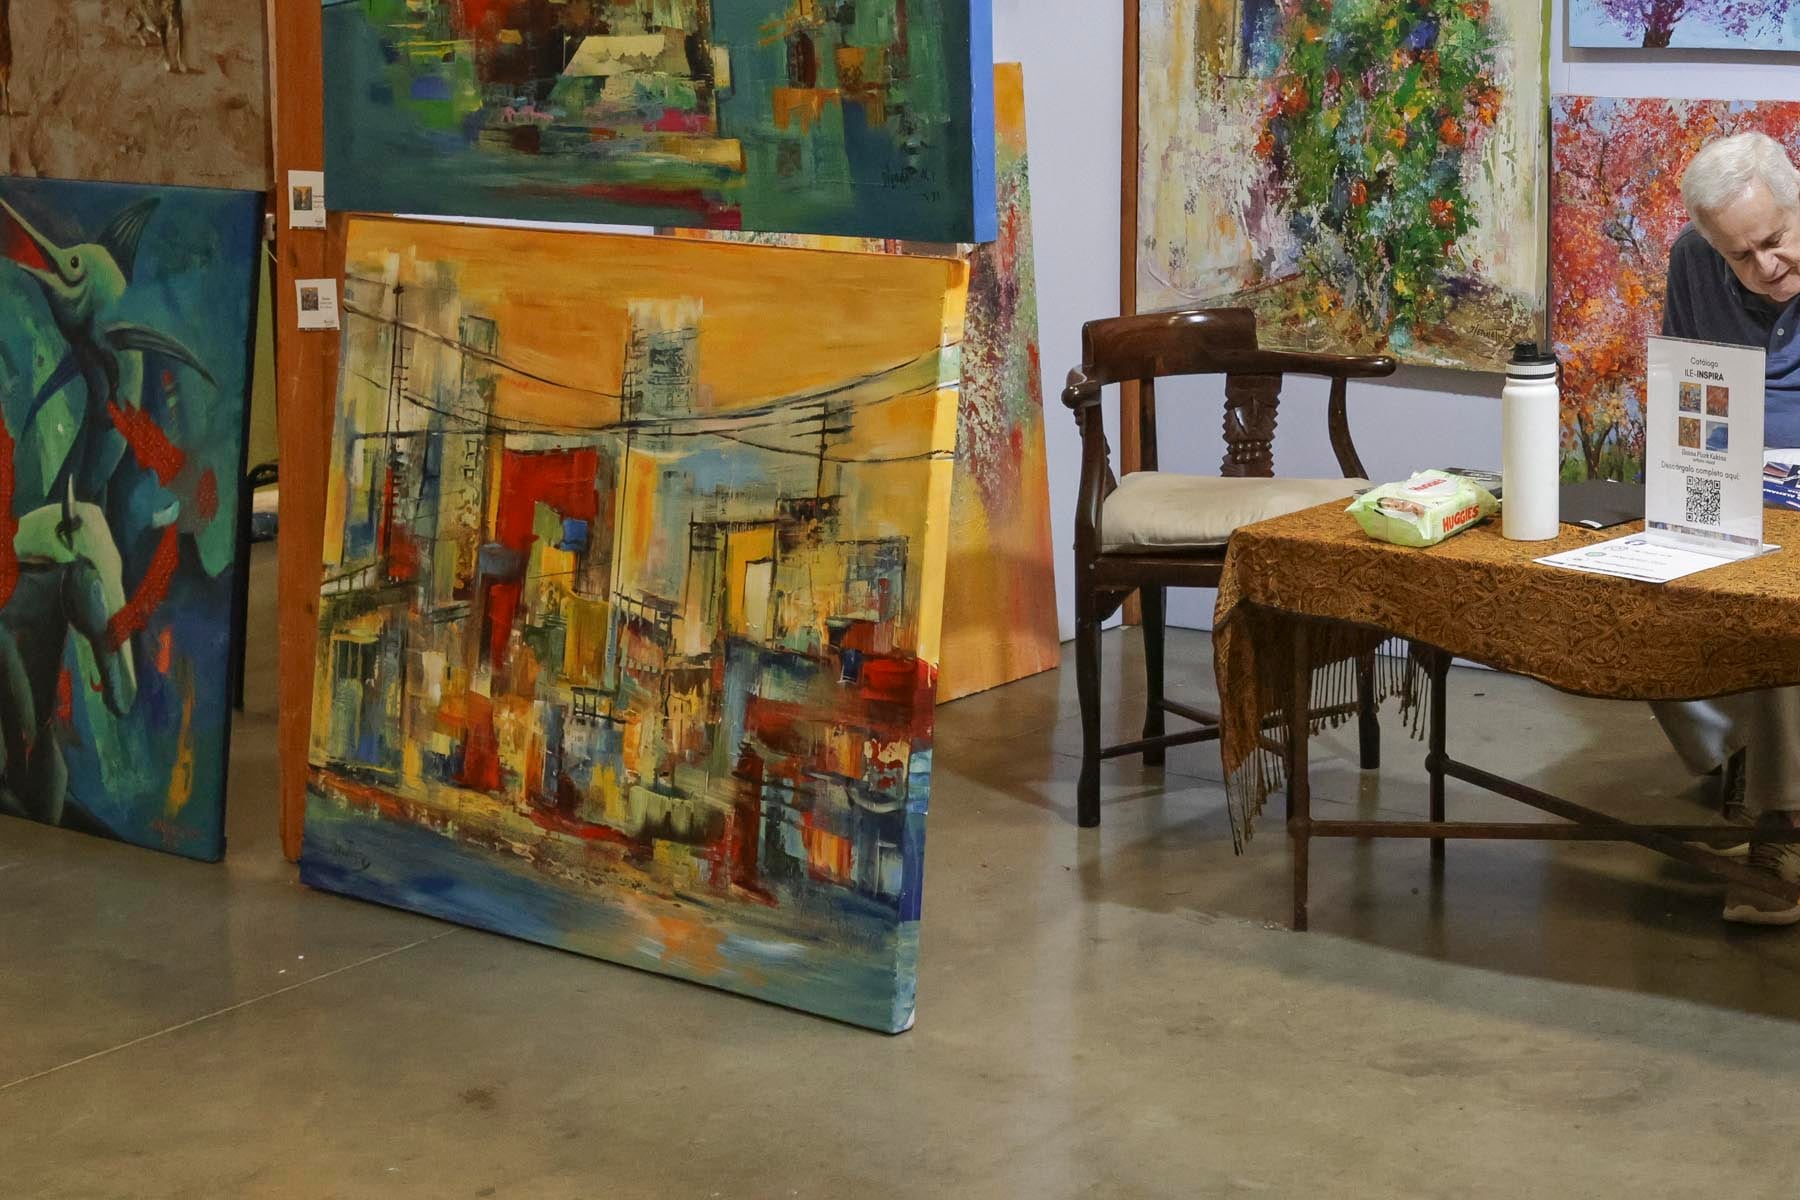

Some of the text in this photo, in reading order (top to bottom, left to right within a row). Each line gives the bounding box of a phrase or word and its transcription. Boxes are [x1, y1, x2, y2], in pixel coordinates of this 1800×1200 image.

[1684, 368, 1725, 381] ILE-INSPIRA
[1696, 468, 1723, 478] completo
[1442, 505, 1480, 532] HUGGIES
